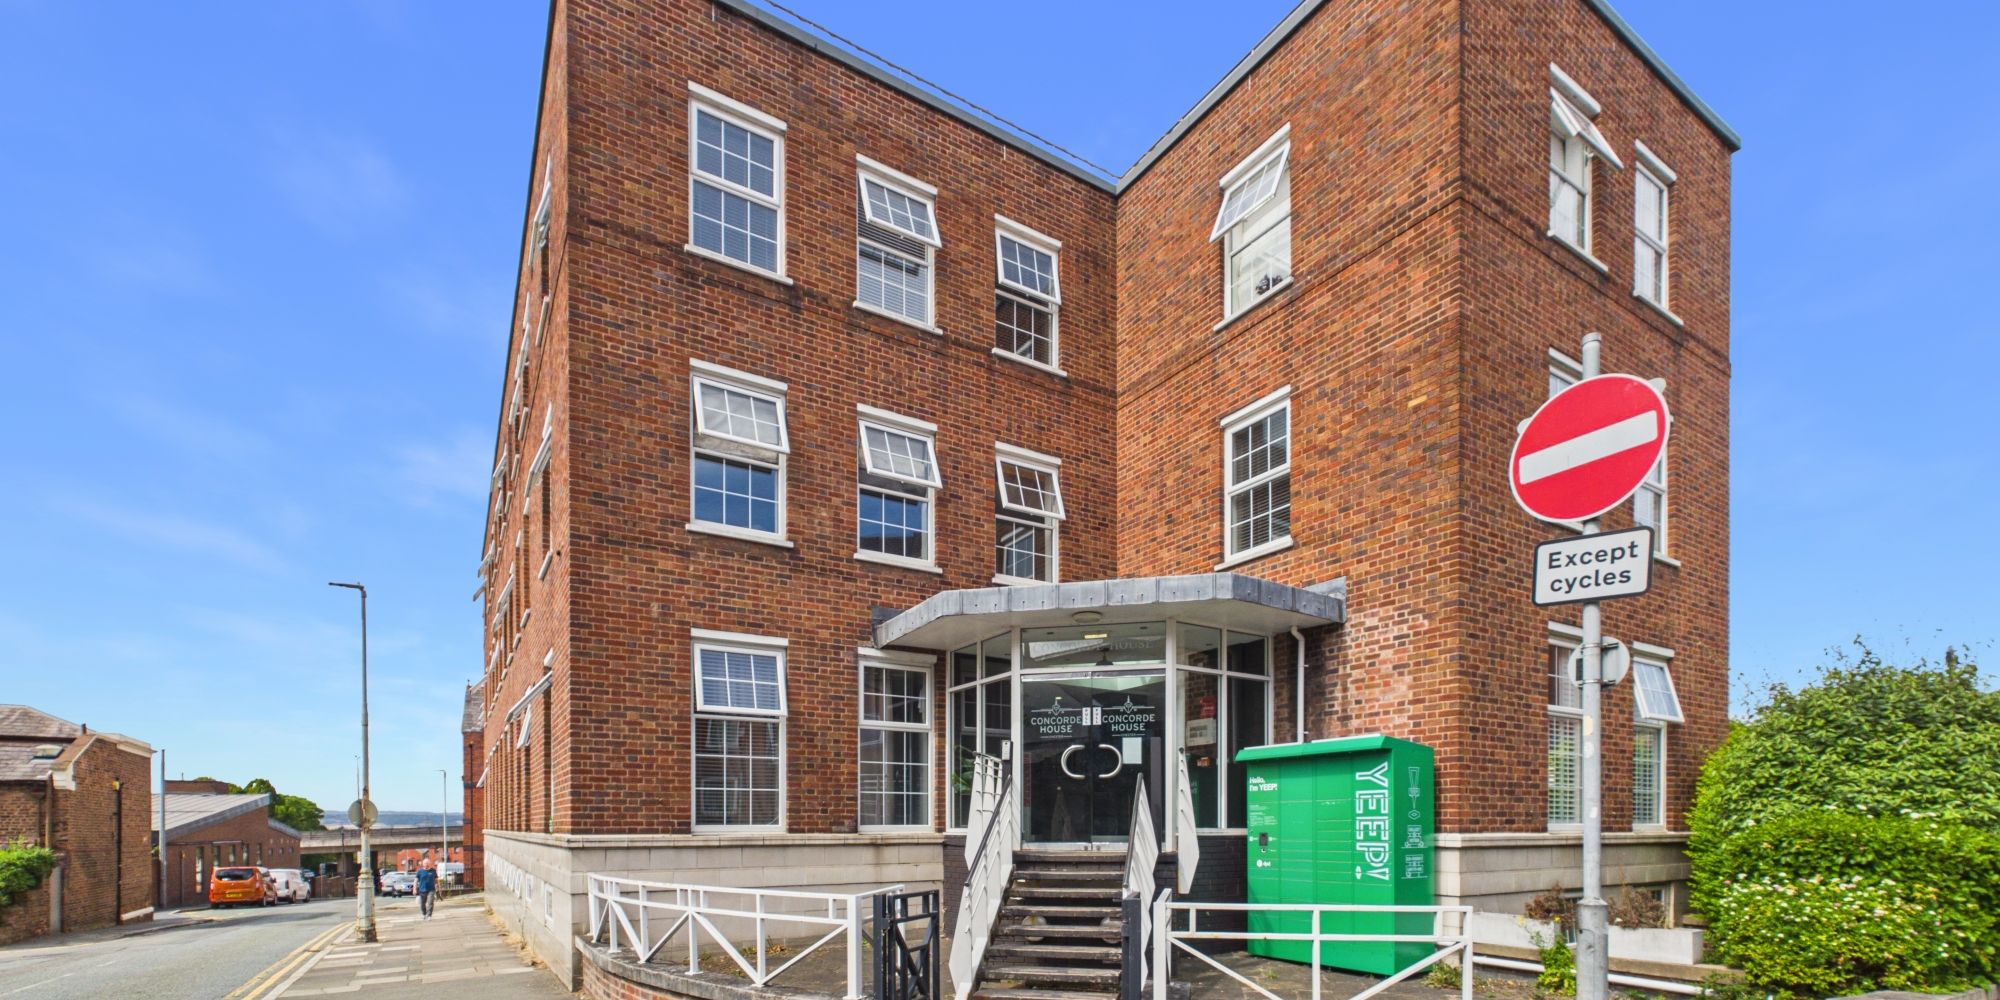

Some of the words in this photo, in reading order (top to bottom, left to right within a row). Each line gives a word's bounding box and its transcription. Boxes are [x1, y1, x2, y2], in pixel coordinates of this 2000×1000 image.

[1548, 541, 1638, 569] Except
[1550, 569, 1632, 593] cycles
[1110, 639, 1153, 651] HOUSE
[1031, 716, 1082, 726] CONCORDE
[1102, 713, 1156, 724] CONCORDE
[1039, 724, 1072, 734] HOUSE
[1111, 723, 1146, 732] HOUSE
[1259, 783, 1278, 791] YEEP!
[1355, 761, 1389, 881] YEEP!
